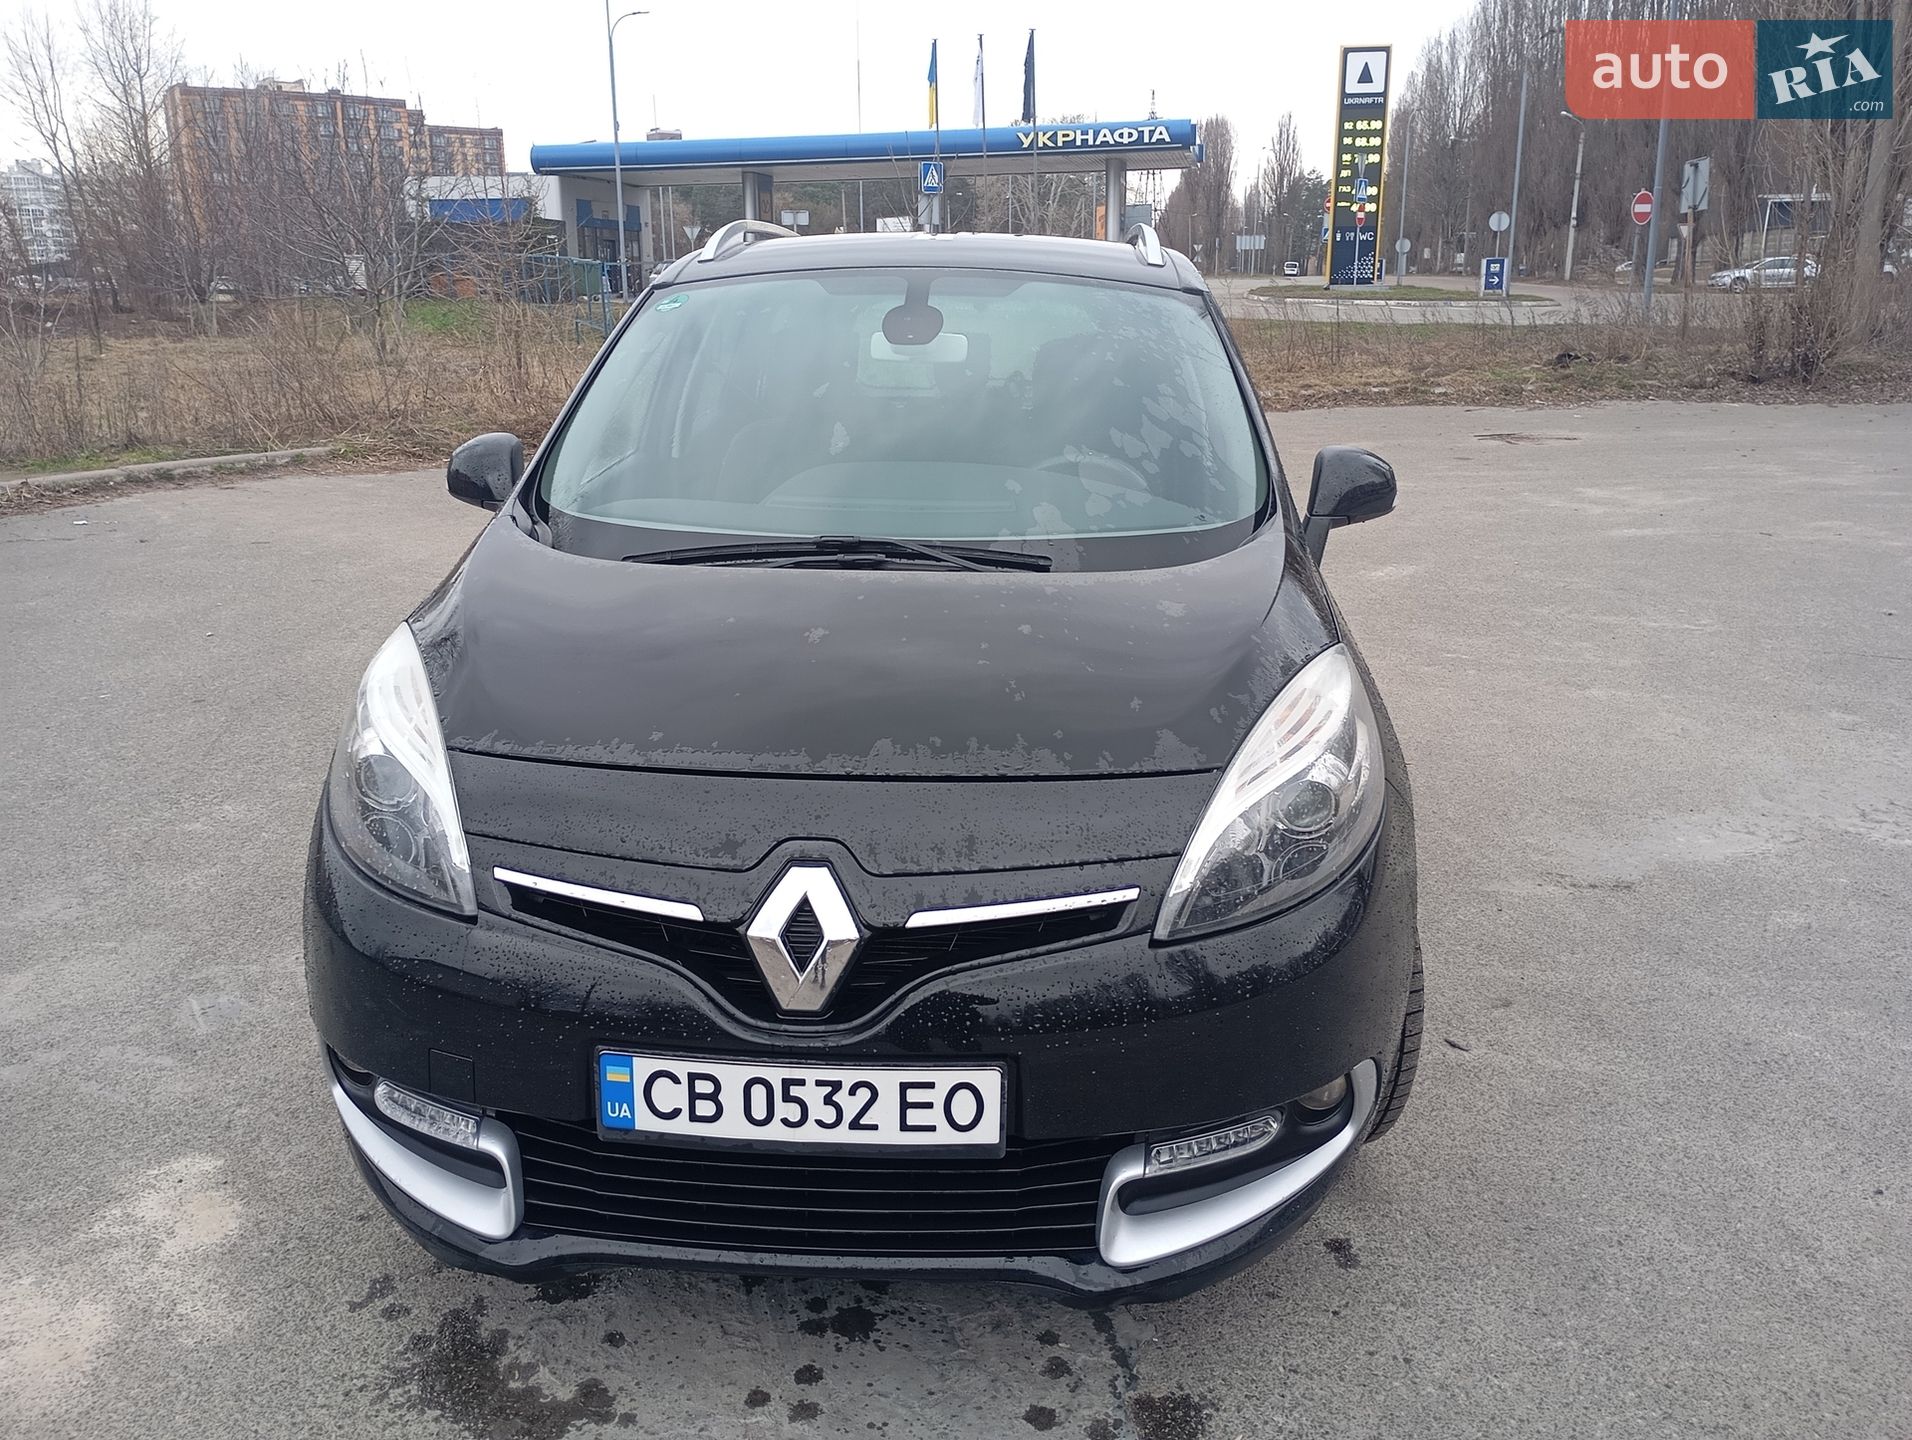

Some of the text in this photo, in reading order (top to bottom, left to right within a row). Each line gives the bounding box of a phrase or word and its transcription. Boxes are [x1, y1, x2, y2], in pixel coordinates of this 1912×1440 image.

[1016, 125, 1171, 148] УКРНАФТА
[1360, 232, 1375, 241] WC
[606, 1101, 632, 1119] UA
[642, 1069, 985, 1133] CB 0532 EO
